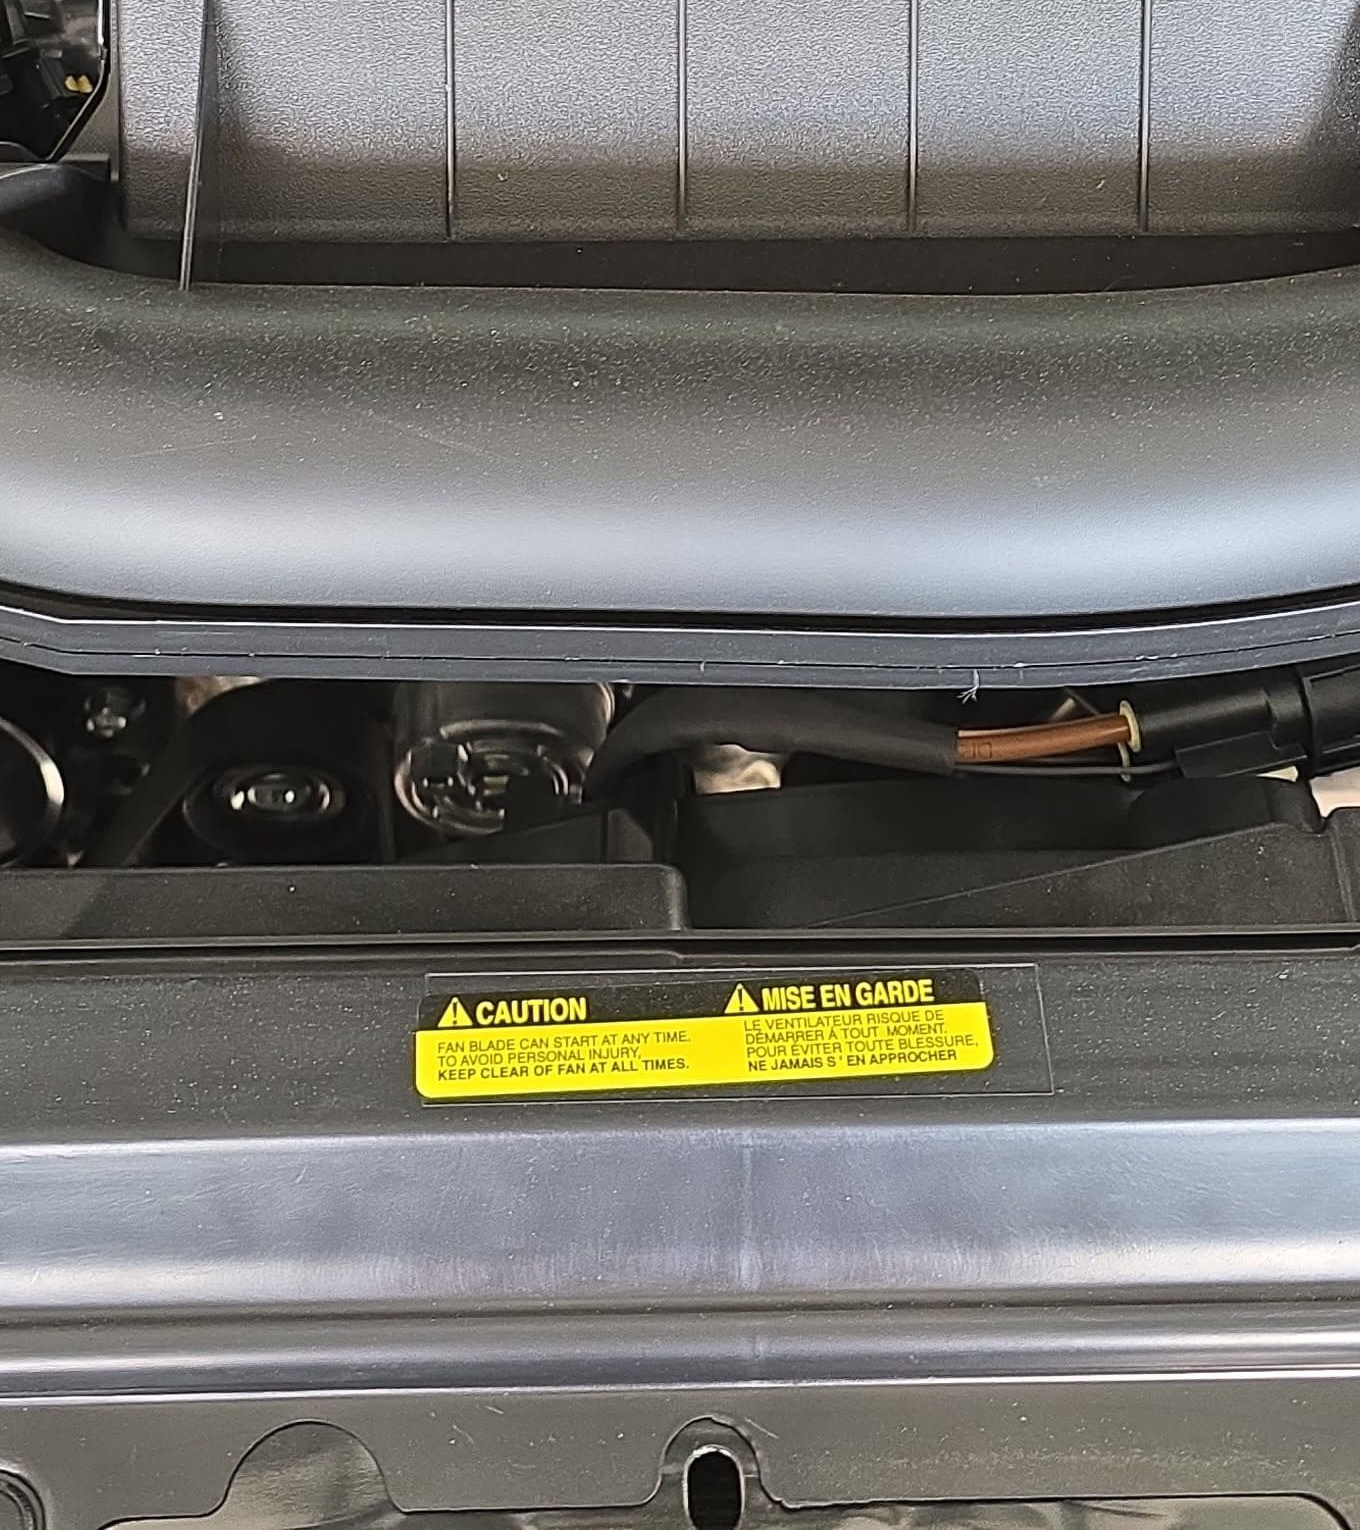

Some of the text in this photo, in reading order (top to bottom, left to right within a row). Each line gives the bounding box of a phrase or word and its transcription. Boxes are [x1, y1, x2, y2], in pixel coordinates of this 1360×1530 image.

[762, 978, 935, 1011] MISE EN GARDE
[476, 997, 587, 1025] CAUTION
[744, 1009, 945, 1031] LE VENTILATEUR RISQUE DE
[437, 1041, 465, 1054] FAN
[469, 1038, 516, 1052] BLADE
[519, 1037, 550, 1050] CAN
[553, 1034, 599, 1048] START
[601, 1033, 618, 1046] AT
[621, 1031, 650, 1045] ANY
[840, 1026, 879, 1040] TOUT
[886, 1022, 948, 1037] MOMENT.
[437, 1046, 641, 1067] TO AVOID PERSONAL INJURY,
[746, 1033, 979, 1059] POUR ÉVITER TOUTE BLESSURE,
[437, 1057, 690, 1081] KEEP CLEAR OF FAN AT ALL TIMES.
[748, 1059, 768, 1072] NE
[771, 1056, 824, 1071] JAMAIS
[847, 1054, 866, 1067] EN
[869, 1049, 957, 1065] APPROCHER
